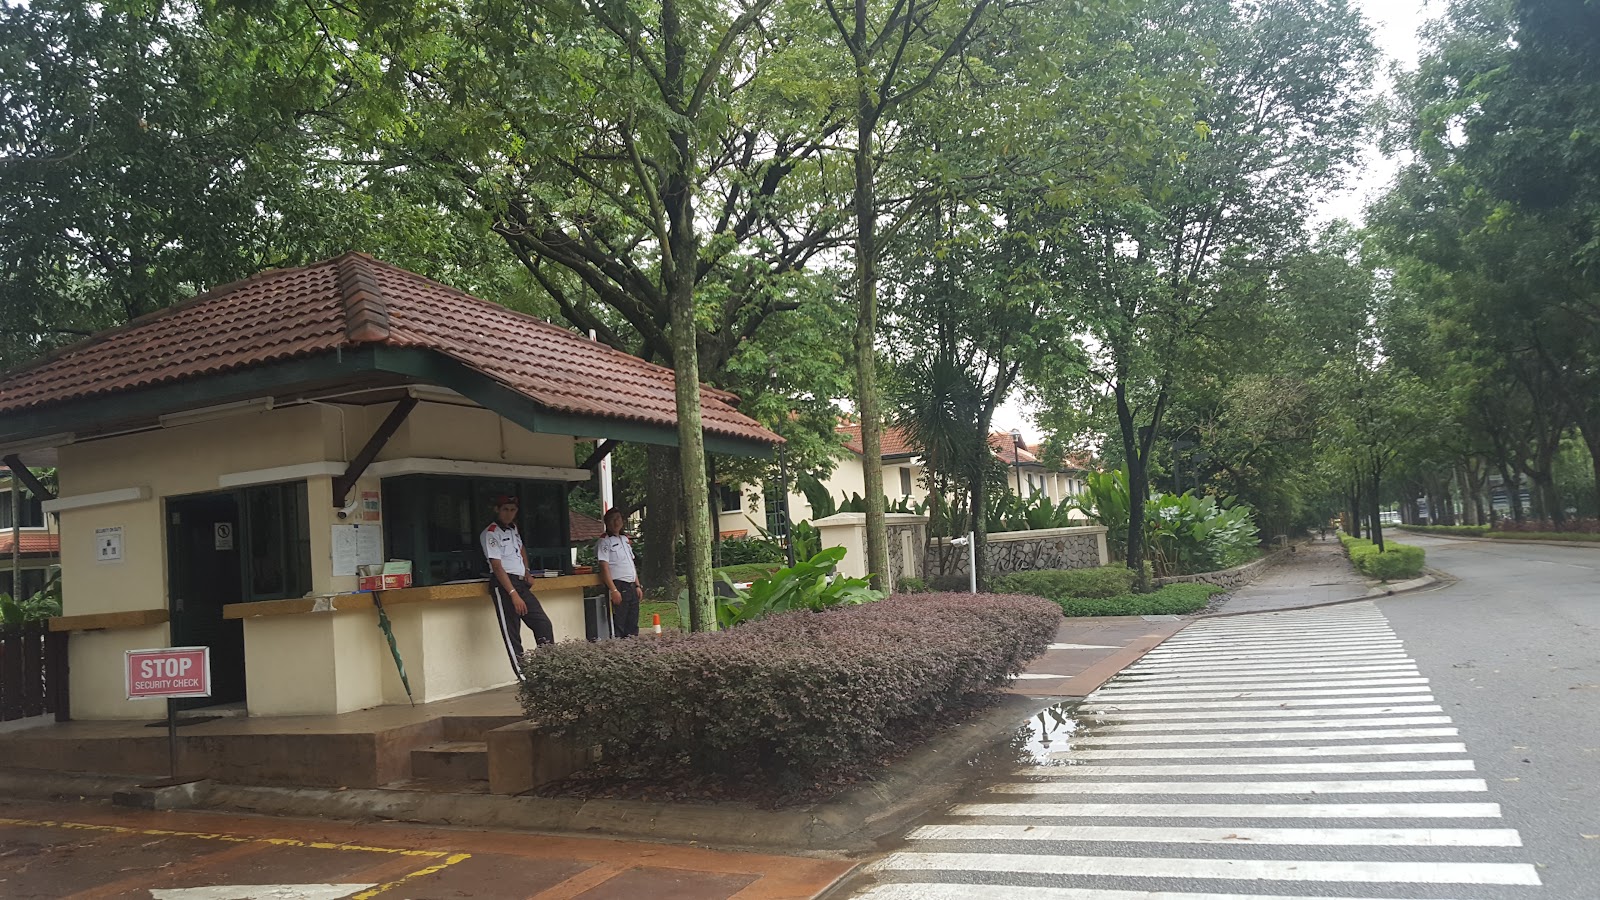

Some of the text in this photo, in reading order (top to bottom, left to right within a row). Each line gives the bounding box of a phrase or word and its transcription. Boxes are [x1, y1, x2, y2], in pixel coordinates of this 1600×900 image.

[141, 657, 192, 679] STOP
[135, 678, 199, 690] SECURITY CHECK
